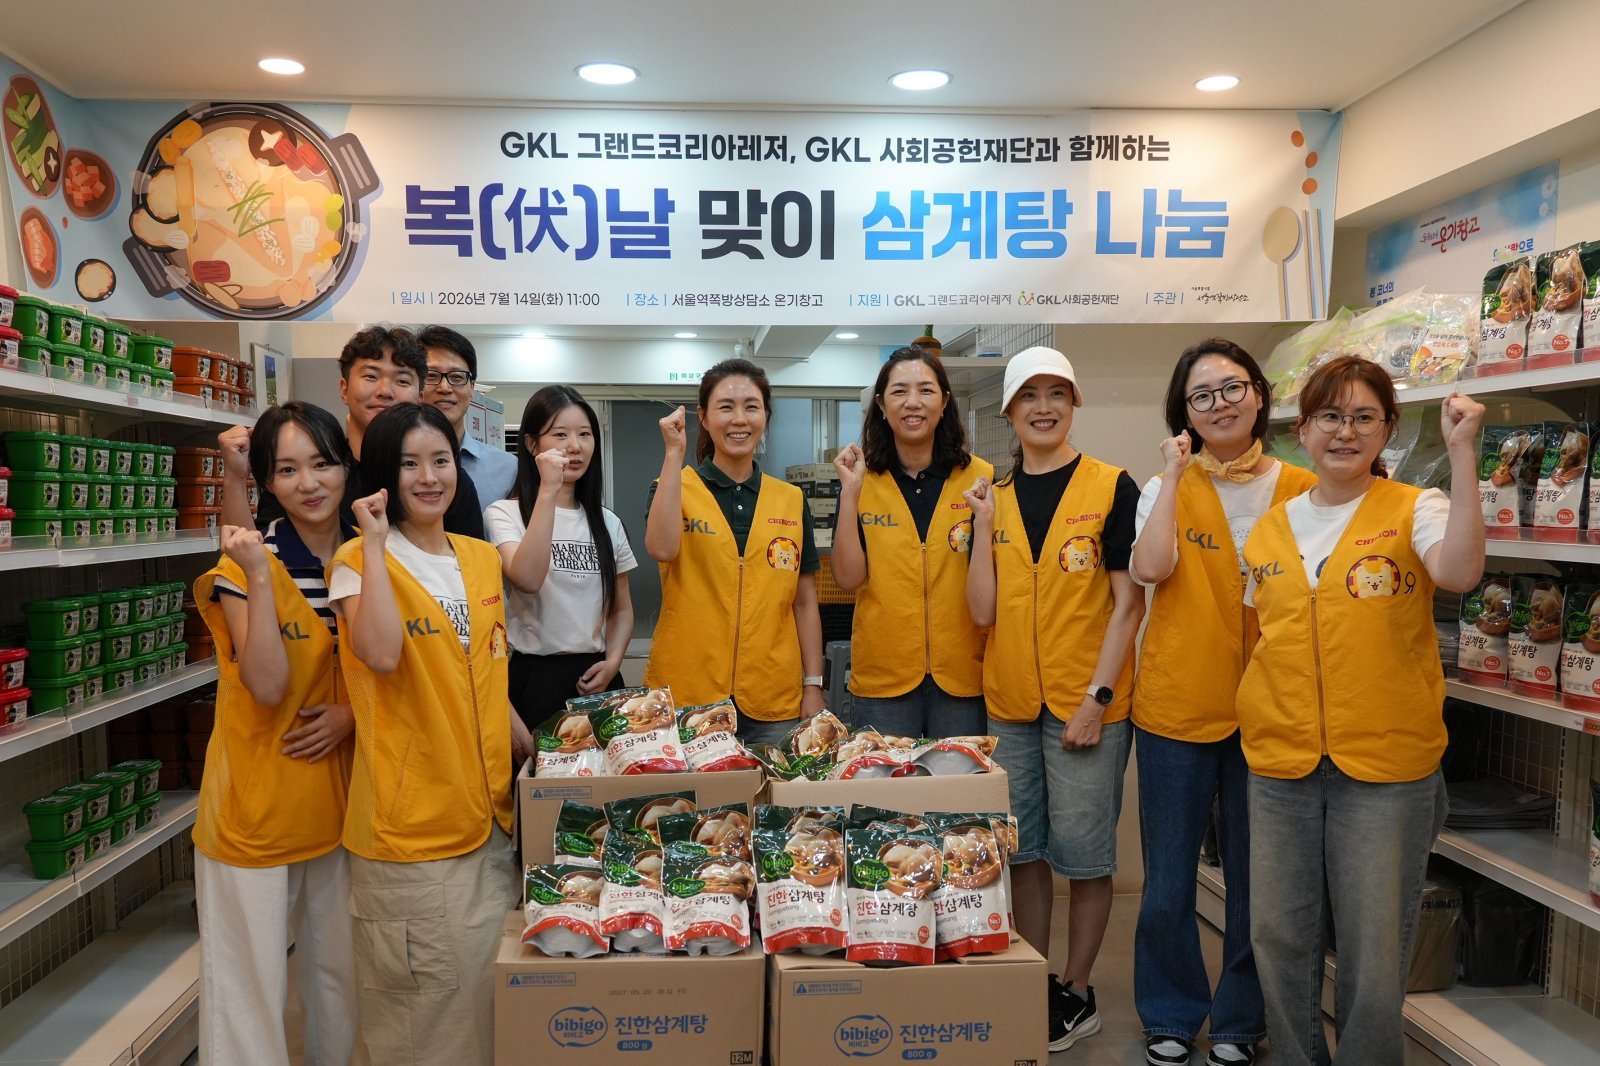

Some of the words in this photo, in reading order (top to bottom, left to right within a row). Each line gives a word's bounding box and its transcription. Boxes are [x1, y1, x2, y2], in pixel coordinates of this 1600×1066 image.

[500, 131, 568, 159] GKL
[577, 132, 796, 164] 그랜드코리아레저,
[805, 136, 871, 163] GKL
[879, 137, 1060, 164] 사회공헌재단과
[1069, 135, 1171, 162] 함께하는
[404, 182, 676, 261] 복(伏)날
[698, 189, 835, 260] 맞이
[862, 189, 1074, 261] 삼계탕
[1095, 188, 1230, 259] 나눔
[1431, 216, 1480, 253] 온기창고
[400, 291, 425, 305] 일시
[438, 292, 486, 306] 2026년
[489, 292, 510, 306] 7월
[513, 292, 563, 306] 14일(화)
[567, 293, 600, 306] 11:00
[634, 293, 660, 306] 장소
[671, 293, 771, 307] 서울역쪽방상담소
[774, 293, 823, 307] 온기창고
[857, 293, 882, 307] 지원
[893, 294, 925, 307] GKL
[927, 293, 1012, 306] 그랜드코리아레저
[1153, 291, 1177, 305] 주관
[860, 511, 899, 527] GKL
[1498, 512, 1513, 520] No.1
[1557, 512, 1573, 520] No.1
[683, 516, 716, 535] GKL
[991, 529, 1010, 546] KL
[279, 621, 311, 641] KL
[405, 616, 441, 638] KL
[1465, 634, 1488, 650] 삼계탕
[1511, 642, 1538, 659] 삼계탕
[1485, 659, 1500, 667] No.1
[1567, 654, 1594, 672] 삼계탕
[1536, 670, 1550, 678] No.1
[624, 731, 658, 748] 삼계탕
[697, 732, 729, 750] 삼계탕
[855, 864, 889, 878] bibigo
[767, 890, 788, 908] 진한
[788, 890, 826, 903] 삼계탕
[944, 893, 983, 913] 삼계탕
[857, 901, 878, 916] 진한
[880, 902, 918, 917] 삼계탕
[555, 1018, 604, 1035] bibigo
[614, 1014, 708, 1036] 진한삼계탕
[900, 1022, 992, 1044] 진한삼계탕
[840, 1027, 889, 1043] bibigo
[907, 1050, 924, 1058] 800
